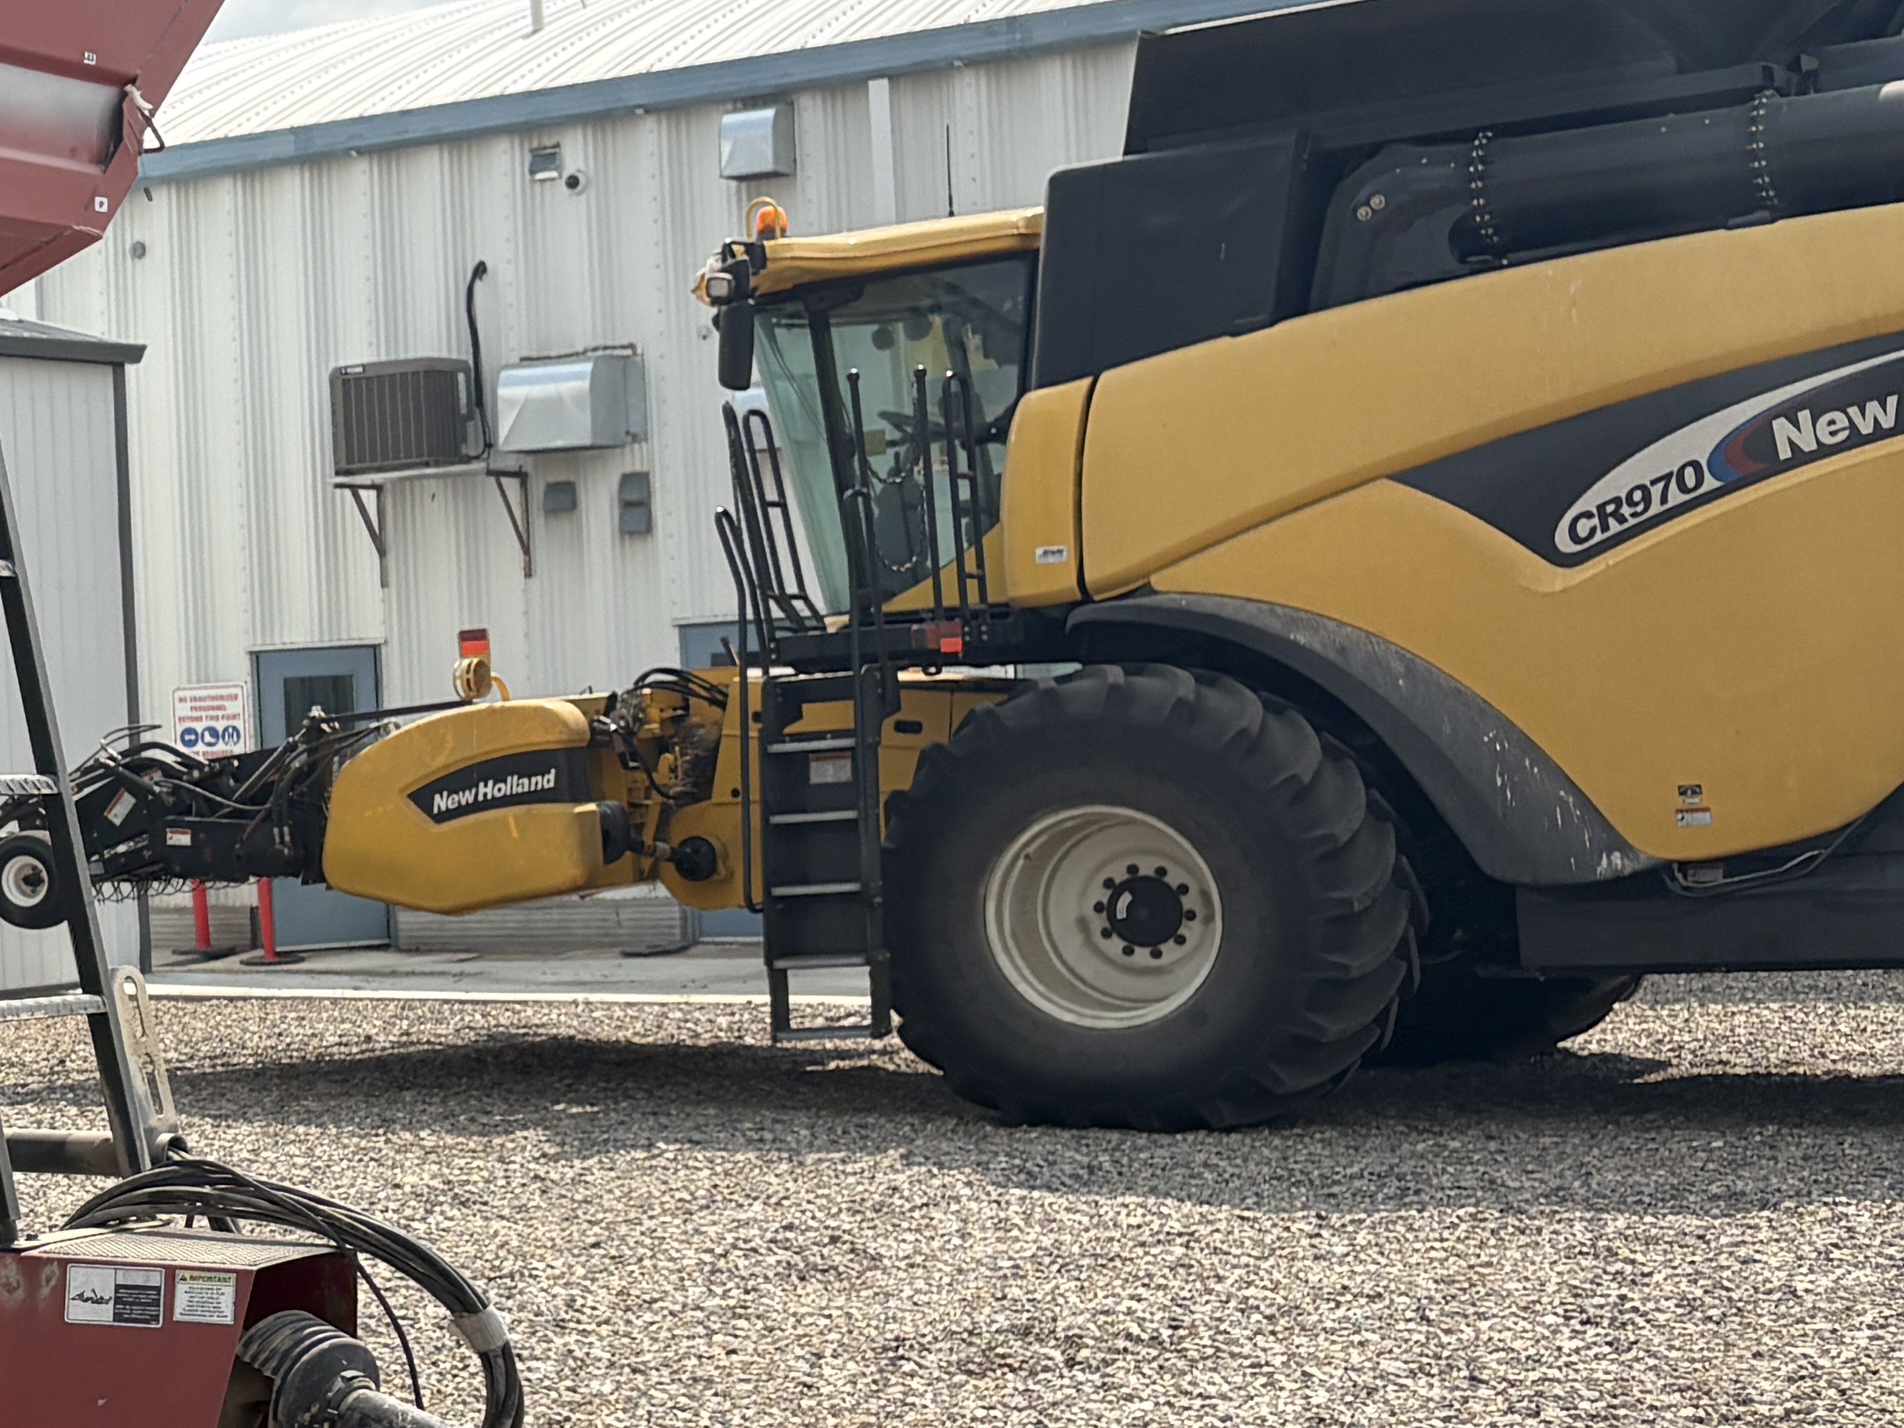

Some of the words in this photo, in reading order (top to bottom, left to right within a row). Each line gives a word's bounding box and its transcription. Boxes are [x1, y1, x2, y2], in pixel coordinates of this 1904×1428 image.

[1771, 394, 1899, 461] New
[1568, 459, 1705, 545] CR970
[433, 787, 476, 814] New
[477, 768, 556, 802] Holland
